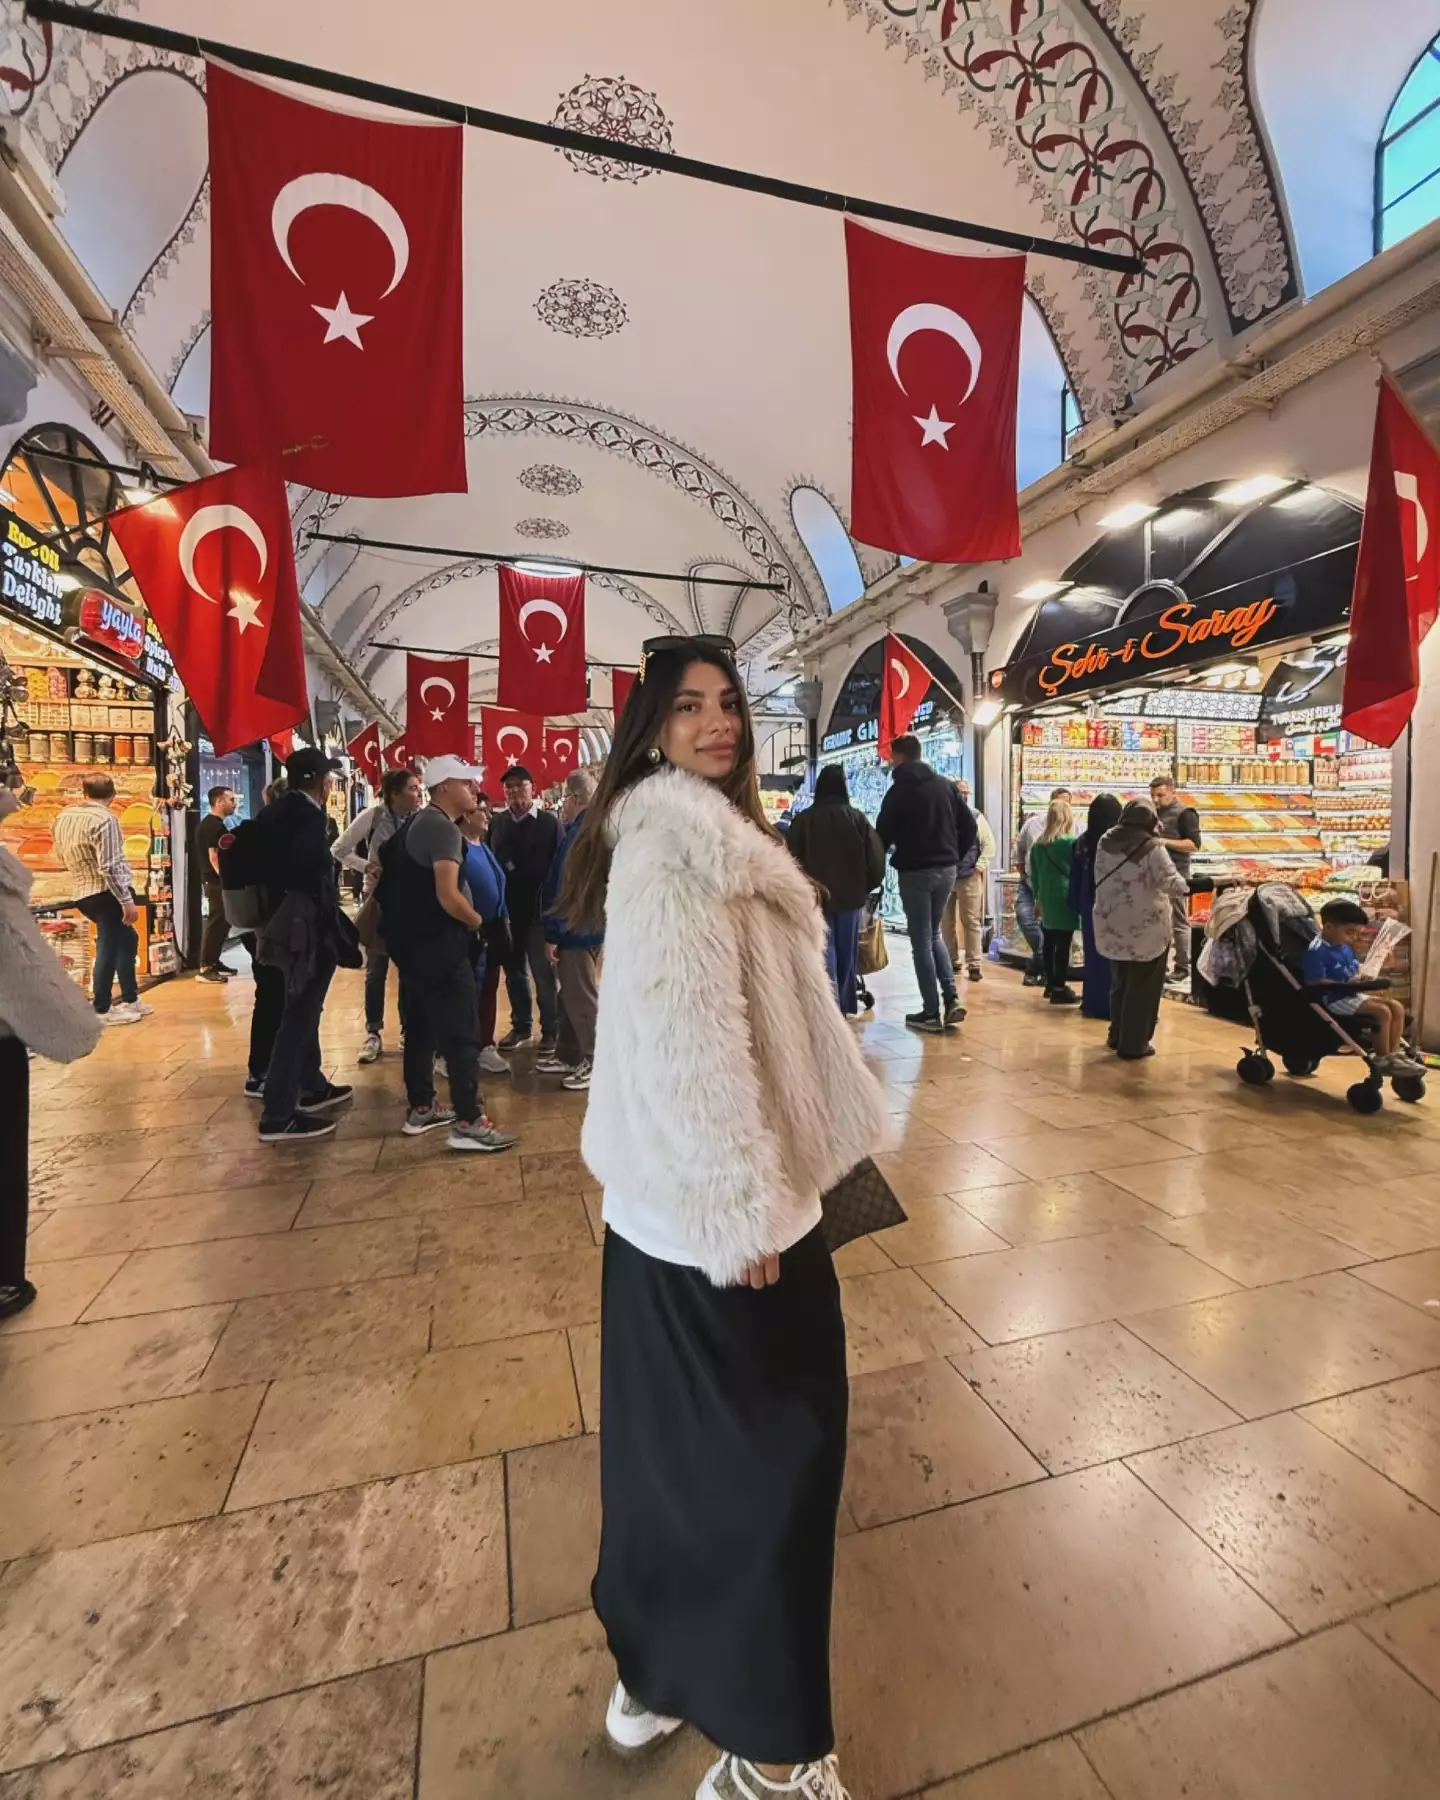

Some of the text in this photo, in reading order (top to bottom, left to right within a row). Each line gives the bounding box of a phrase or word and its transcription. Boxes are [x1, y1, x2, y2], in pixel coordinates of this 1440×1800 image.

[2, 541, 63, 599] Turkish
[40, 544, 60, 572] Oil
[2, 570, 62, 626] Delight
[100, 599, 142, 644] yayla
[1038, 597, 1277, 697] Şehr-i Saray
